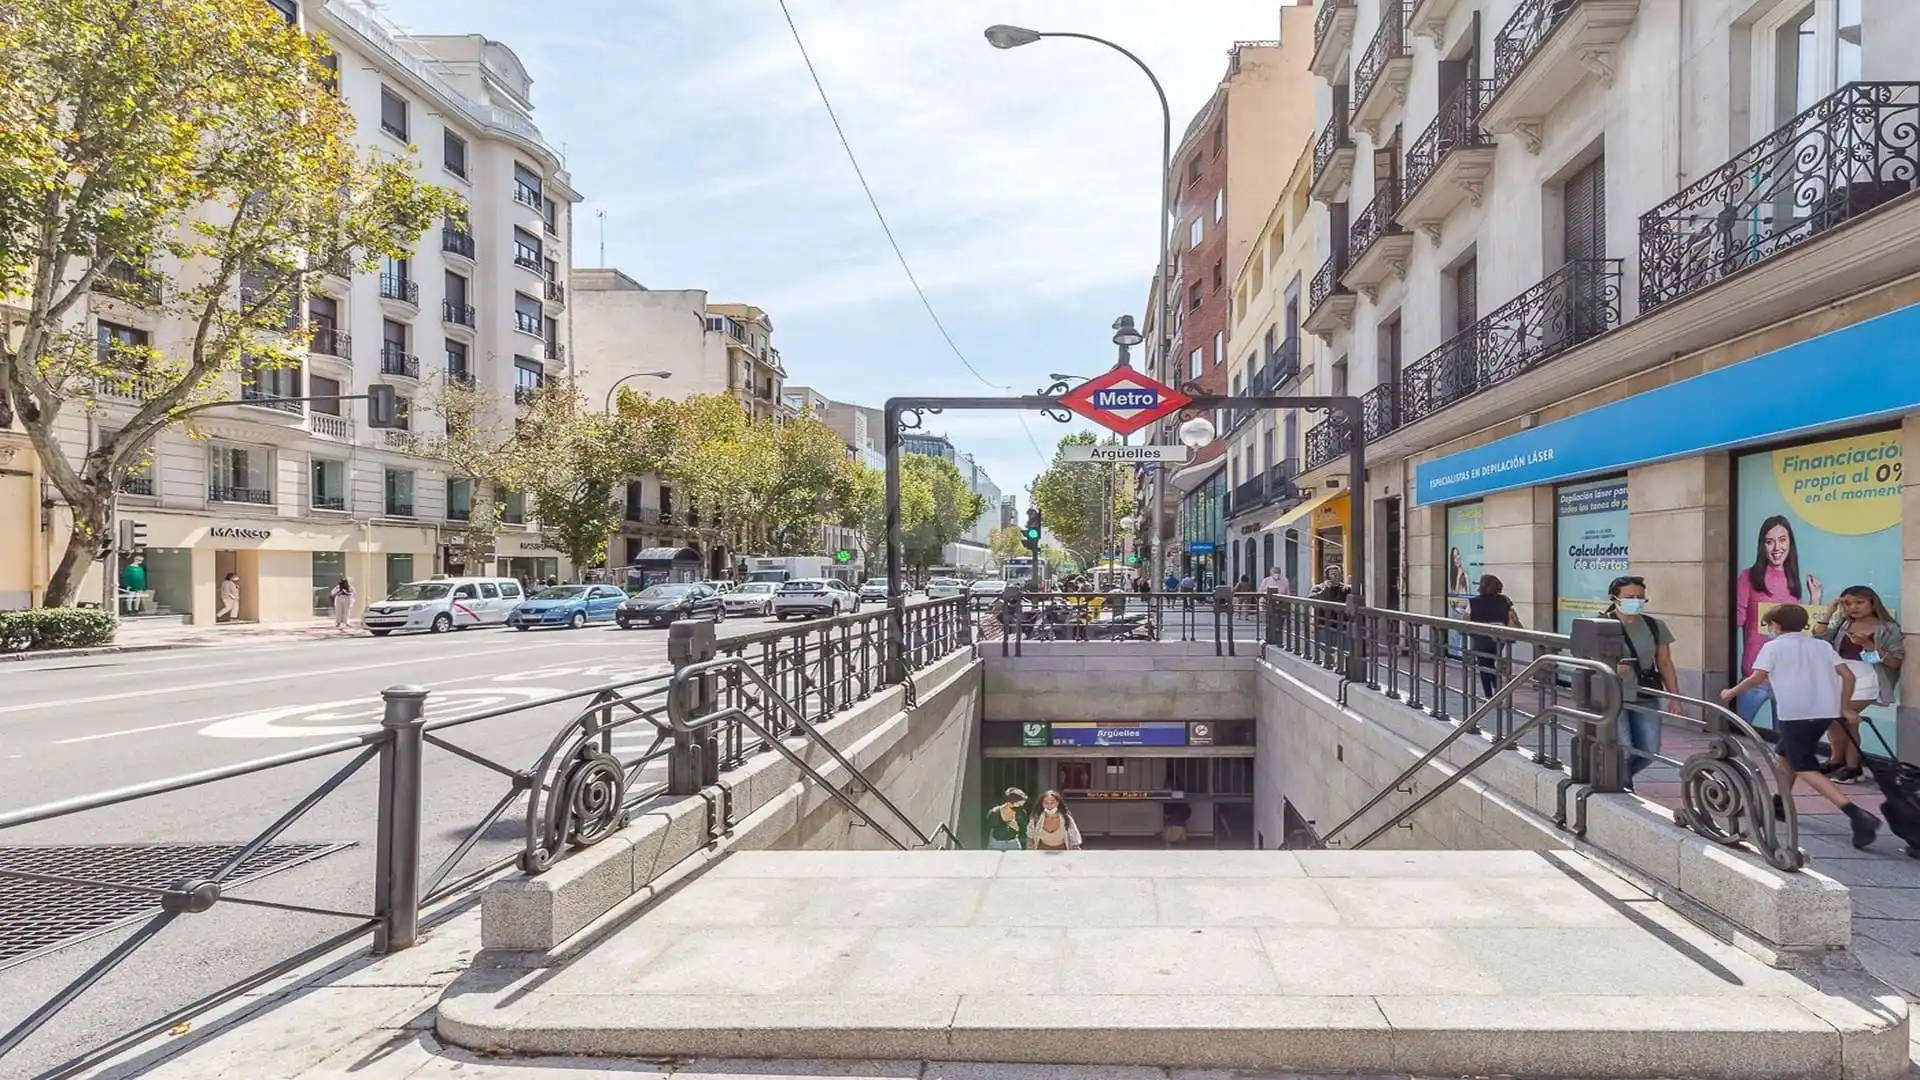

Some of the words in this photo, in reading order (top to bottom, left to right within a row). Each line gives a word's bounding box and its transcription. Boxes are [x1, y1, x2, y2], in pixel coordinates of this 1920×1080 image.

[1099, 391, 1154, 406] Metro
[1090, 448, 1161, 460] Argüelles
[1782, 440, 1903, 474] Financiació
[1429, 470, 1470, 489] ESPECIALISTAS
[1471, 468, 1481, 479] EN
[1481, 455, 1525, 476] DEPILACIÓN
[1527, 448, 1554, 465] LÁSER
[1793, 471, 1846, 494] propia
[1852, 466, 1869, 484] al
[1560, 491, 1593, 504] Depilación
[1805, 494, 1821, 504] en
[1825, 488, 1837, 501] el
[1841, 486, 1903, 500] moment
[1611, 499, 1620, 508] de
[1575, 558, 1588, 570] de
[1589, 558, 1629, 570] ofertas
[1096, 729, 1140, 738] Argüelles
